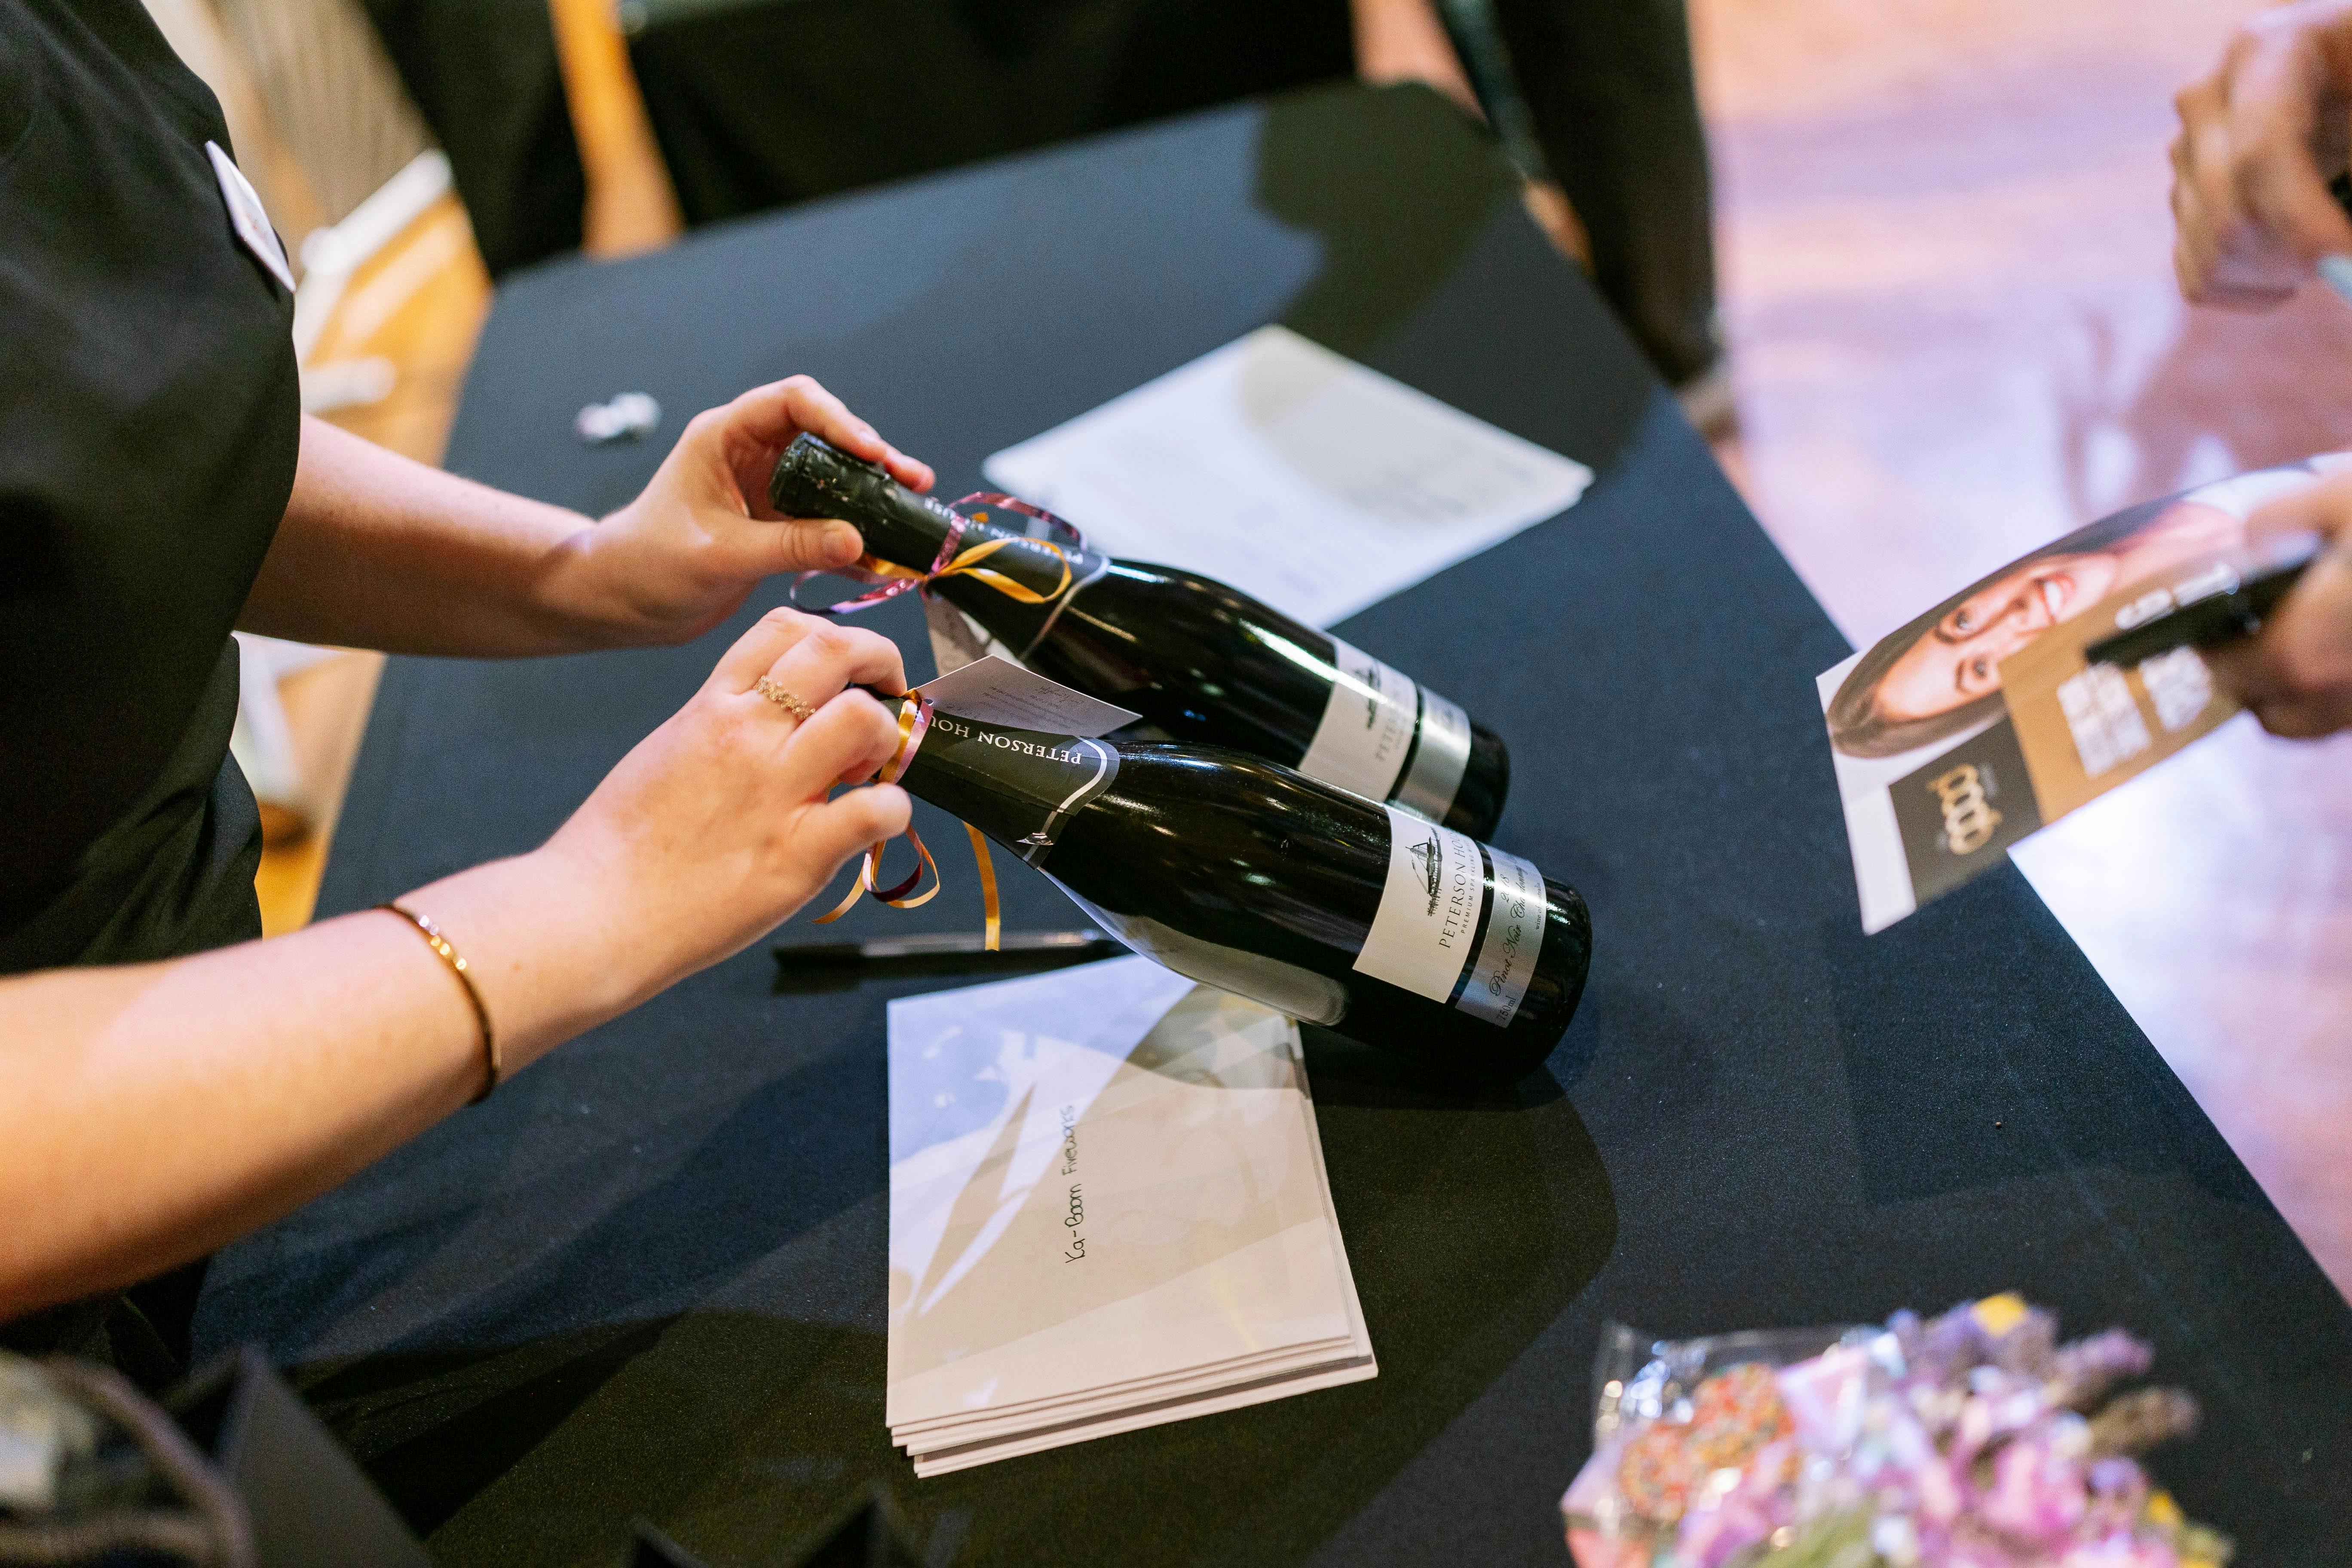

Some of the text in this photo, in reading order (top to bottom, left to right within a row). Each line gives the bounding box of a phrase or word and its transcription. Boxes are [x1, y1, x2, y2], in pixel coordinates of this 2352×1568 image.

[931, 716, 1082, 765] PETERSON HOU
[1439, 862, 1466, 949] PETERSON
[1461, 895, 1474, 934] PREMIUM
[1489, 865, 1528, 996] Pinot Noir Chadonnay
[1497, 995, 1516, 1020] 750ml
[1064, 1183, 1086, 1264] Ka-Boom
